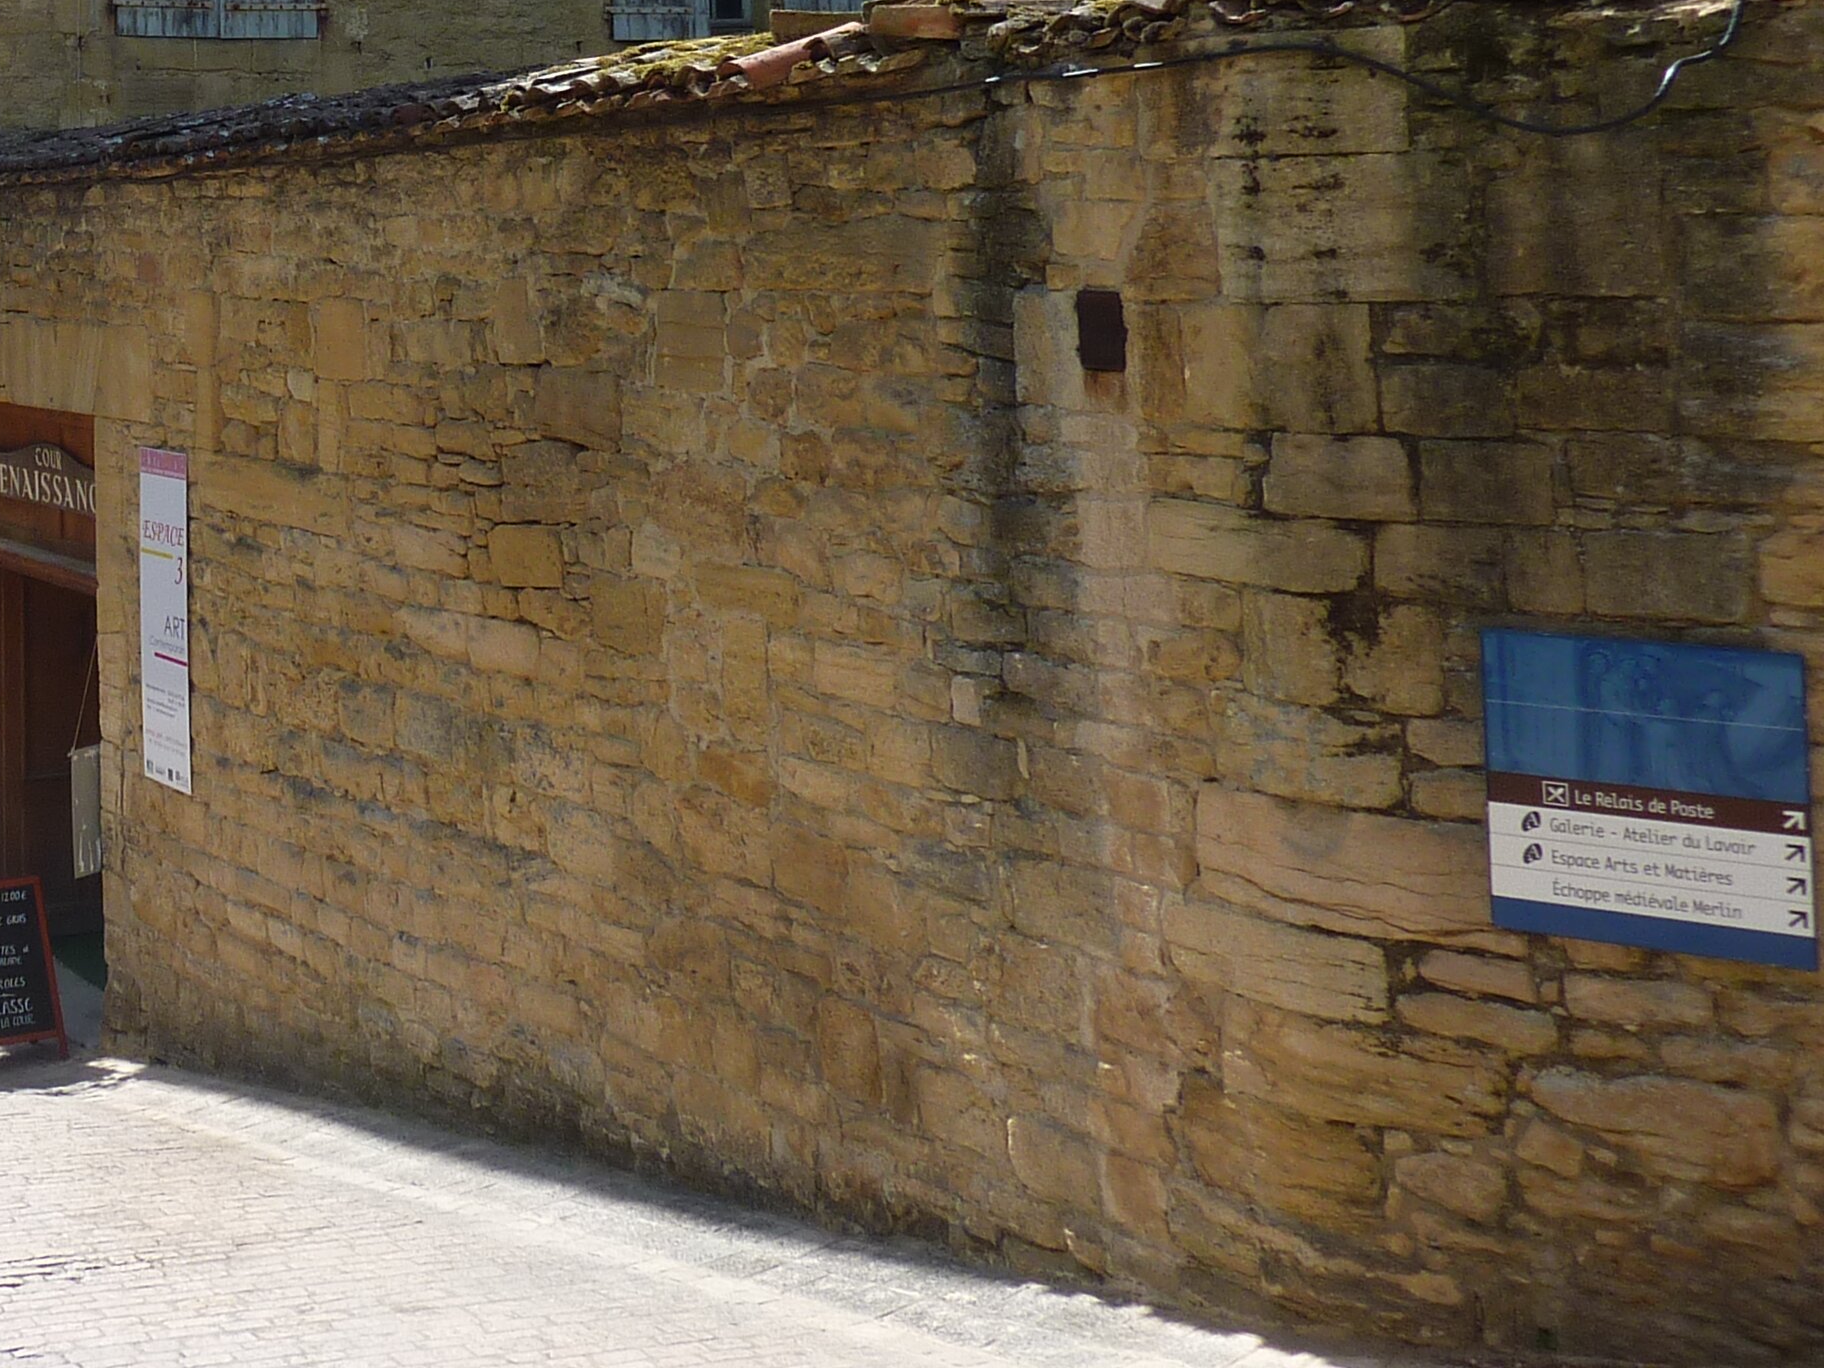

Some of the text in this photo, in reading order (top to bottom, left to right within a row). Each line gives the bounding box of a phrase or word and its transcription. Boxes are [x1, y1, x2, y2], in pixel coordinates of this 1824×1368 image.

[35, 447, 62, 471] COUR
[143, 519, 184, 547] ESPACE
[174, 557, 184, 585] 3
[164, 615, 185, 641] ART
[1574, 789, 1715, 819] Le Relais de Poste
[1549, 817, 1605, 838] Galerie
[1623, 826, 1678, 846] Atelier
[1682, 833, 1702, 849] du
[1551, 849, 1734, 886] Espace Arts et Matières
[1614, 890, 1689, 913] médiévale
[1692, 898, 1743, 919] Merlin
